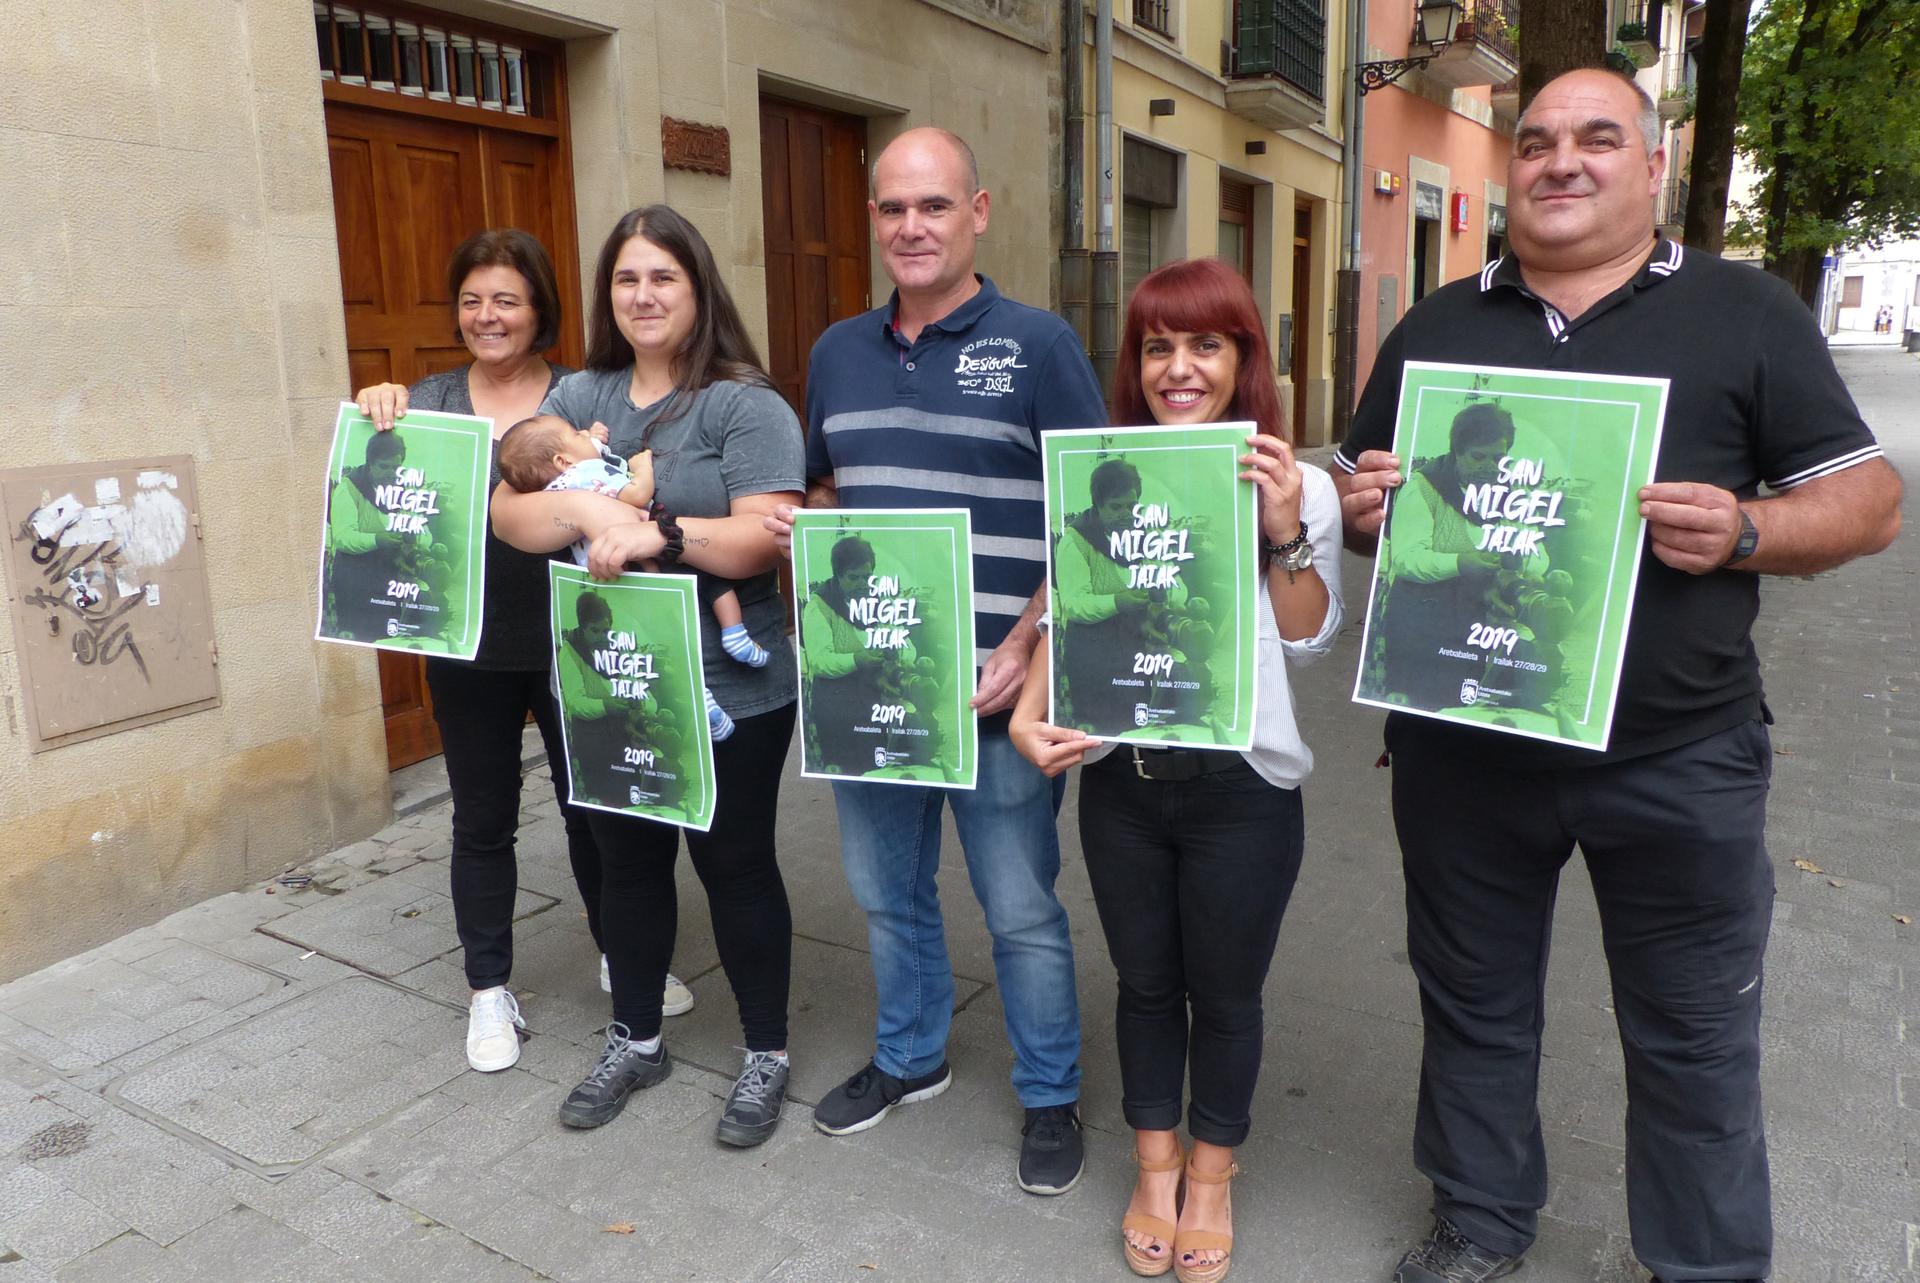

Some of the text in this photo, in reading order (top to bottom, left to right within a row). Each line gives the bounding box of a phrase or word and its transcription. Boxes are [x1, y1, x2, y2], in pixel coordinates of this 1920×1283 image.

[961, 343, 975, 354] NO
[988, 338, 1001, 346] LO
[984, 375, 1015, 393] DSGL
[396, 466, 424, 487] SAN
[1497, 456, 1543, 485] SAN
[375, 485, 440, 514] MIGEL
[1462, 483, 1566, 526] MIGEL
[385, 513, 428, 534] JAIAK
[1132, 502, 1168, 528] SAN
[1110, 528, 1195, 562] MIGEL
[1475, 523, 1545, 556] JAIAK
[868, 574, 899, 597] SAN
[1126, 564, 1180, 589] JAIAK
[387, 580, 420, 602] 2019
[849, 597, 922, 625] MIGEL
[608, 630, 636, 651] SAN
[864, 627, 910, 649] JAIAK
[1466, 622, 1519, 656] 2019
[593, 649, 660, 679] MIGEL
[1133, 652, 1174, 678] 2019
[1493, 657, 1513, 667] Irailak
[1514, 660, 1548, 673] 27/28/29
[609, 678, 649, 699] JAIAK
[1173, 681, 1200, 690] 27/28/29
[871, 703, 906, 727] 2019
[624, 746, 655, 768] 2019
